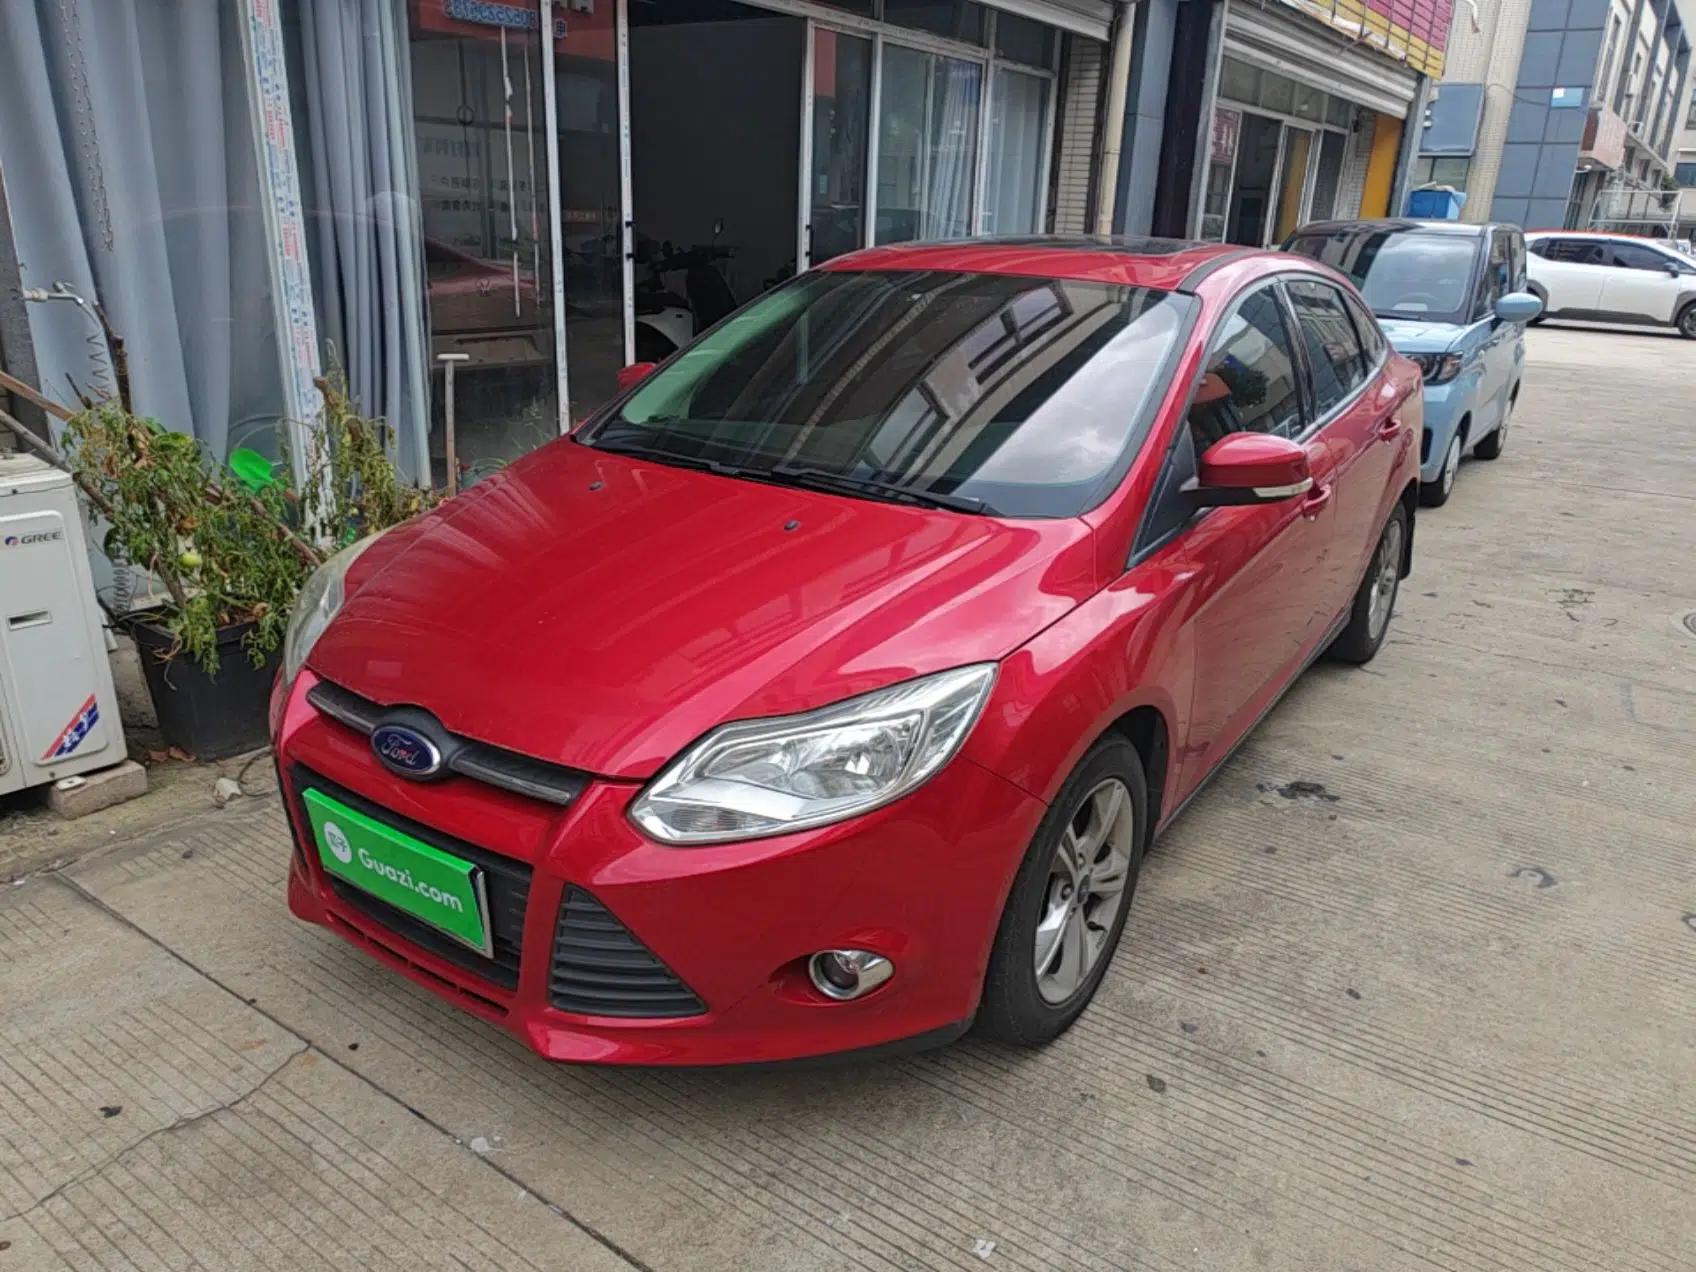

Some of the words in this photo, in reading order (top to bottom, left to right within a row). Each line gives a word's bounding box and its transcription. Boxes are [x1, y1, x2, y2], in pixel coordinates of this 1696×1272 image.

[20, 532, 64, 545] GREE
[381, 733, 420, 765] Ford
[357, 848, 464, 913] Guazi.com
